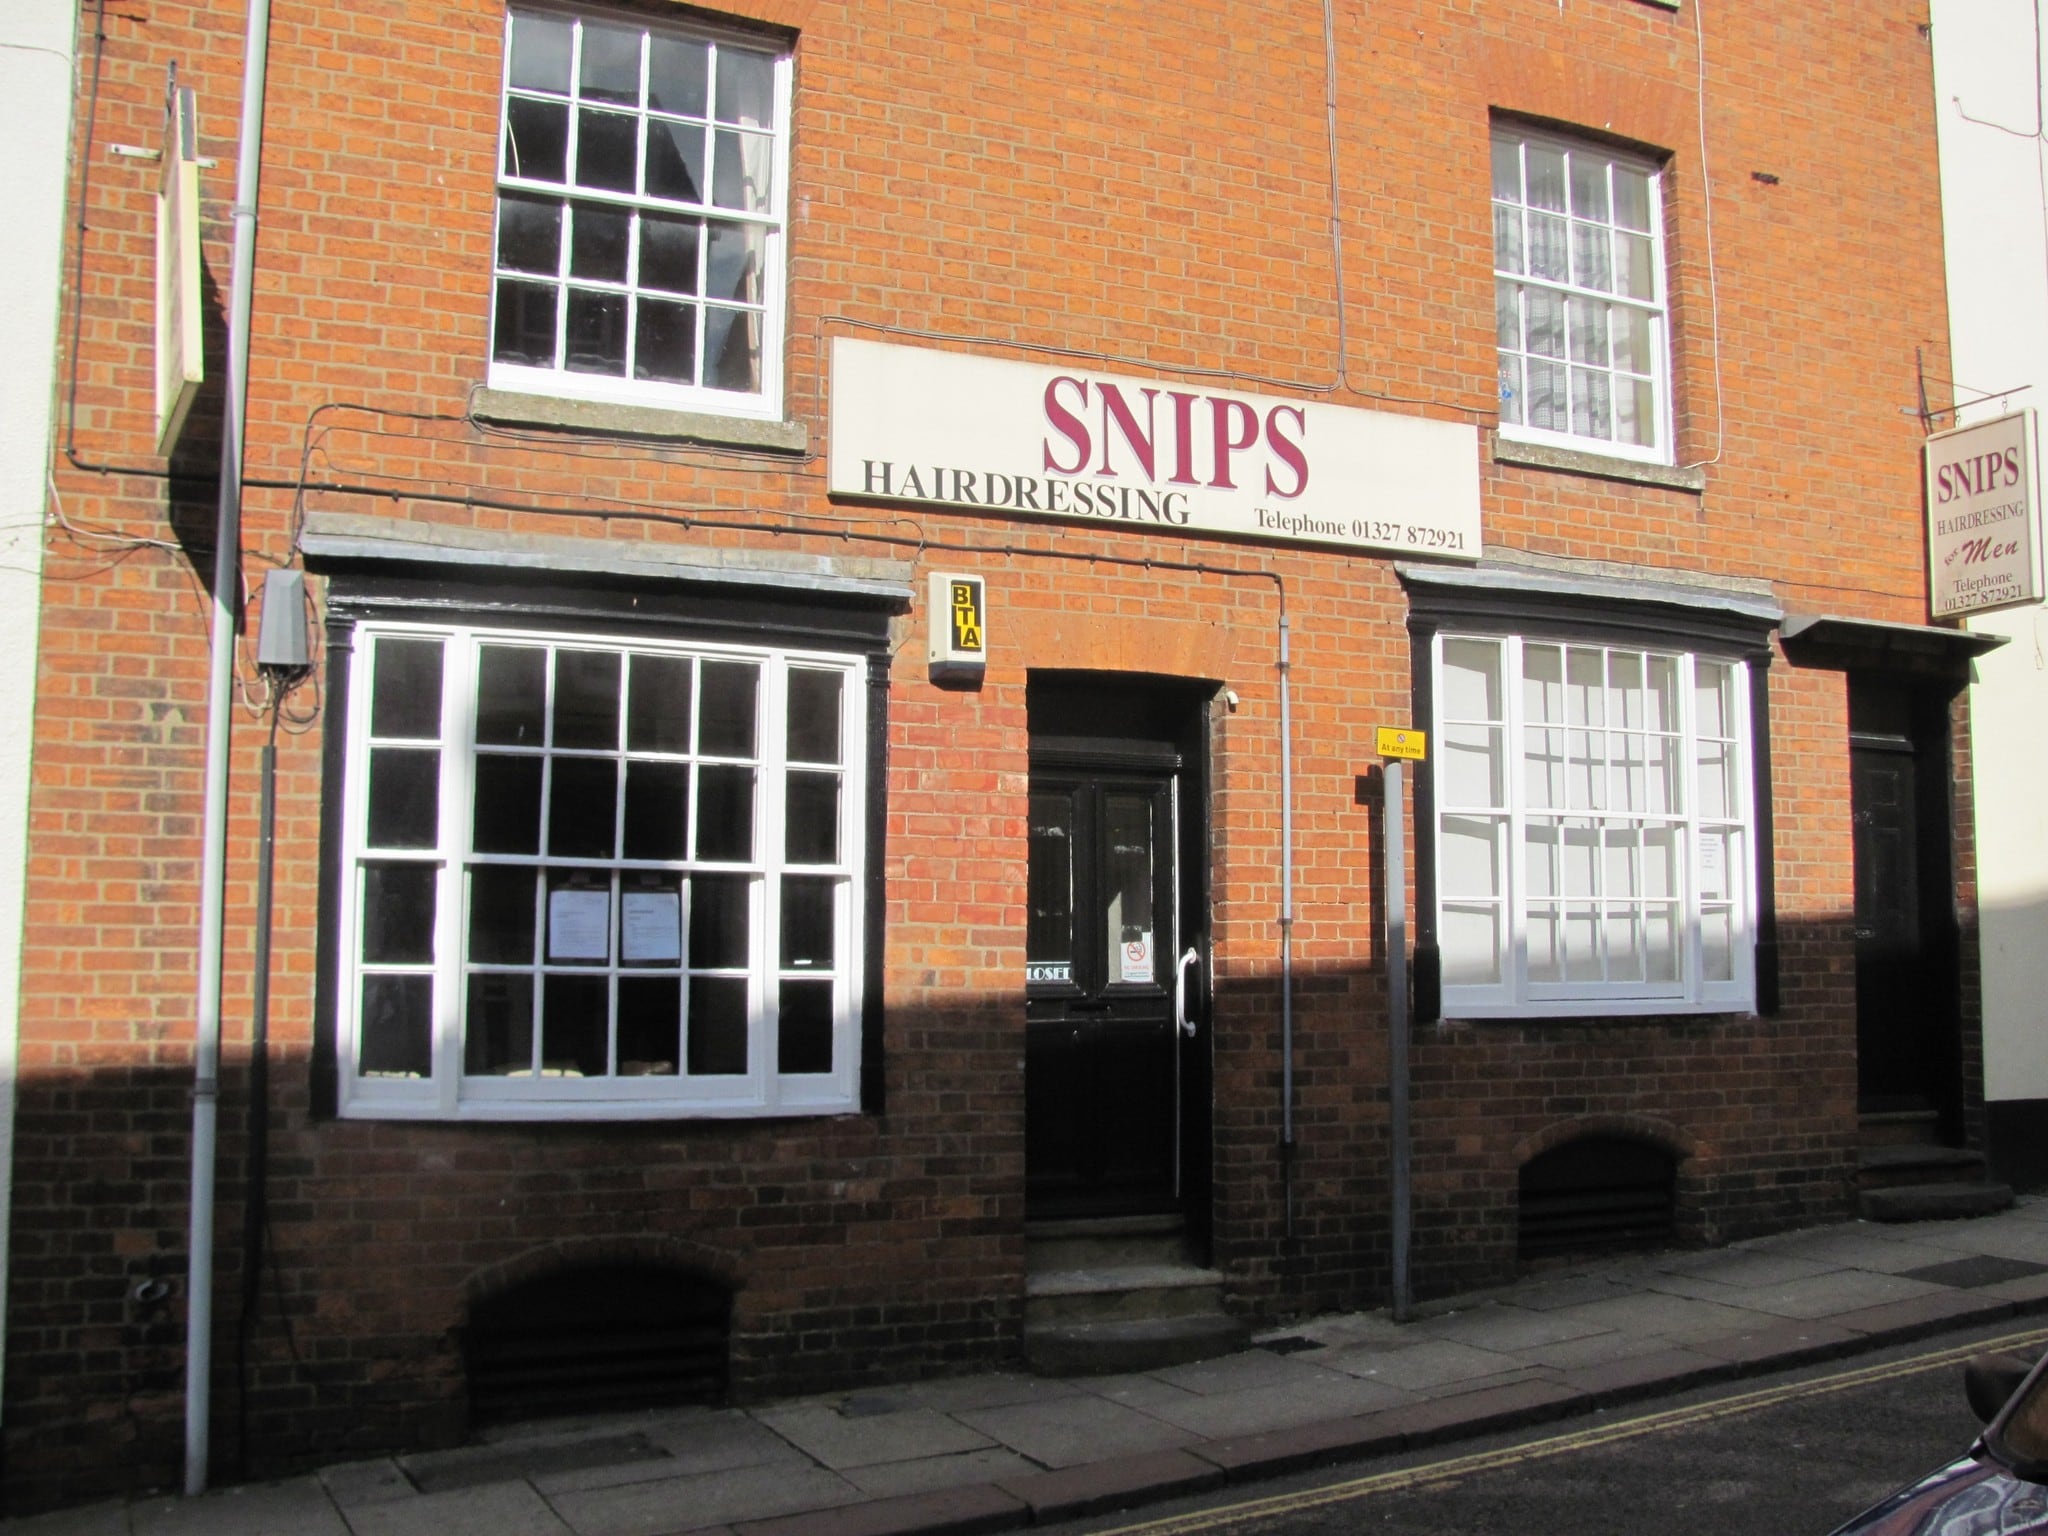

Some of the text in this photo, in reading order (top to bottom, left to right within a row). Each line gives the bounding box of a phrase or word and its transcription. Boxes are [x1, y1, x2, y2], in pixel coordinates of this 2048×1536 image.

[1043, 375, 1309, 499] SNIPS
[862, 459, 1192, 526] HAIRDRESSING
[1938, 447, 2019, 504] SNIPS
[1254, 508, 1465, 550] Telephone 01327 872921
[1938, 501, 2024, 536] HAIRDRESSING
[1962, 536, 2018, 565] Men
[1945, 585, 2023, 612] 01327 872921
[1953, 572, 2013, 593] Telephone
[953, 586, 980, 646] BTA
[1381, 743, 1421, 754] At any time
